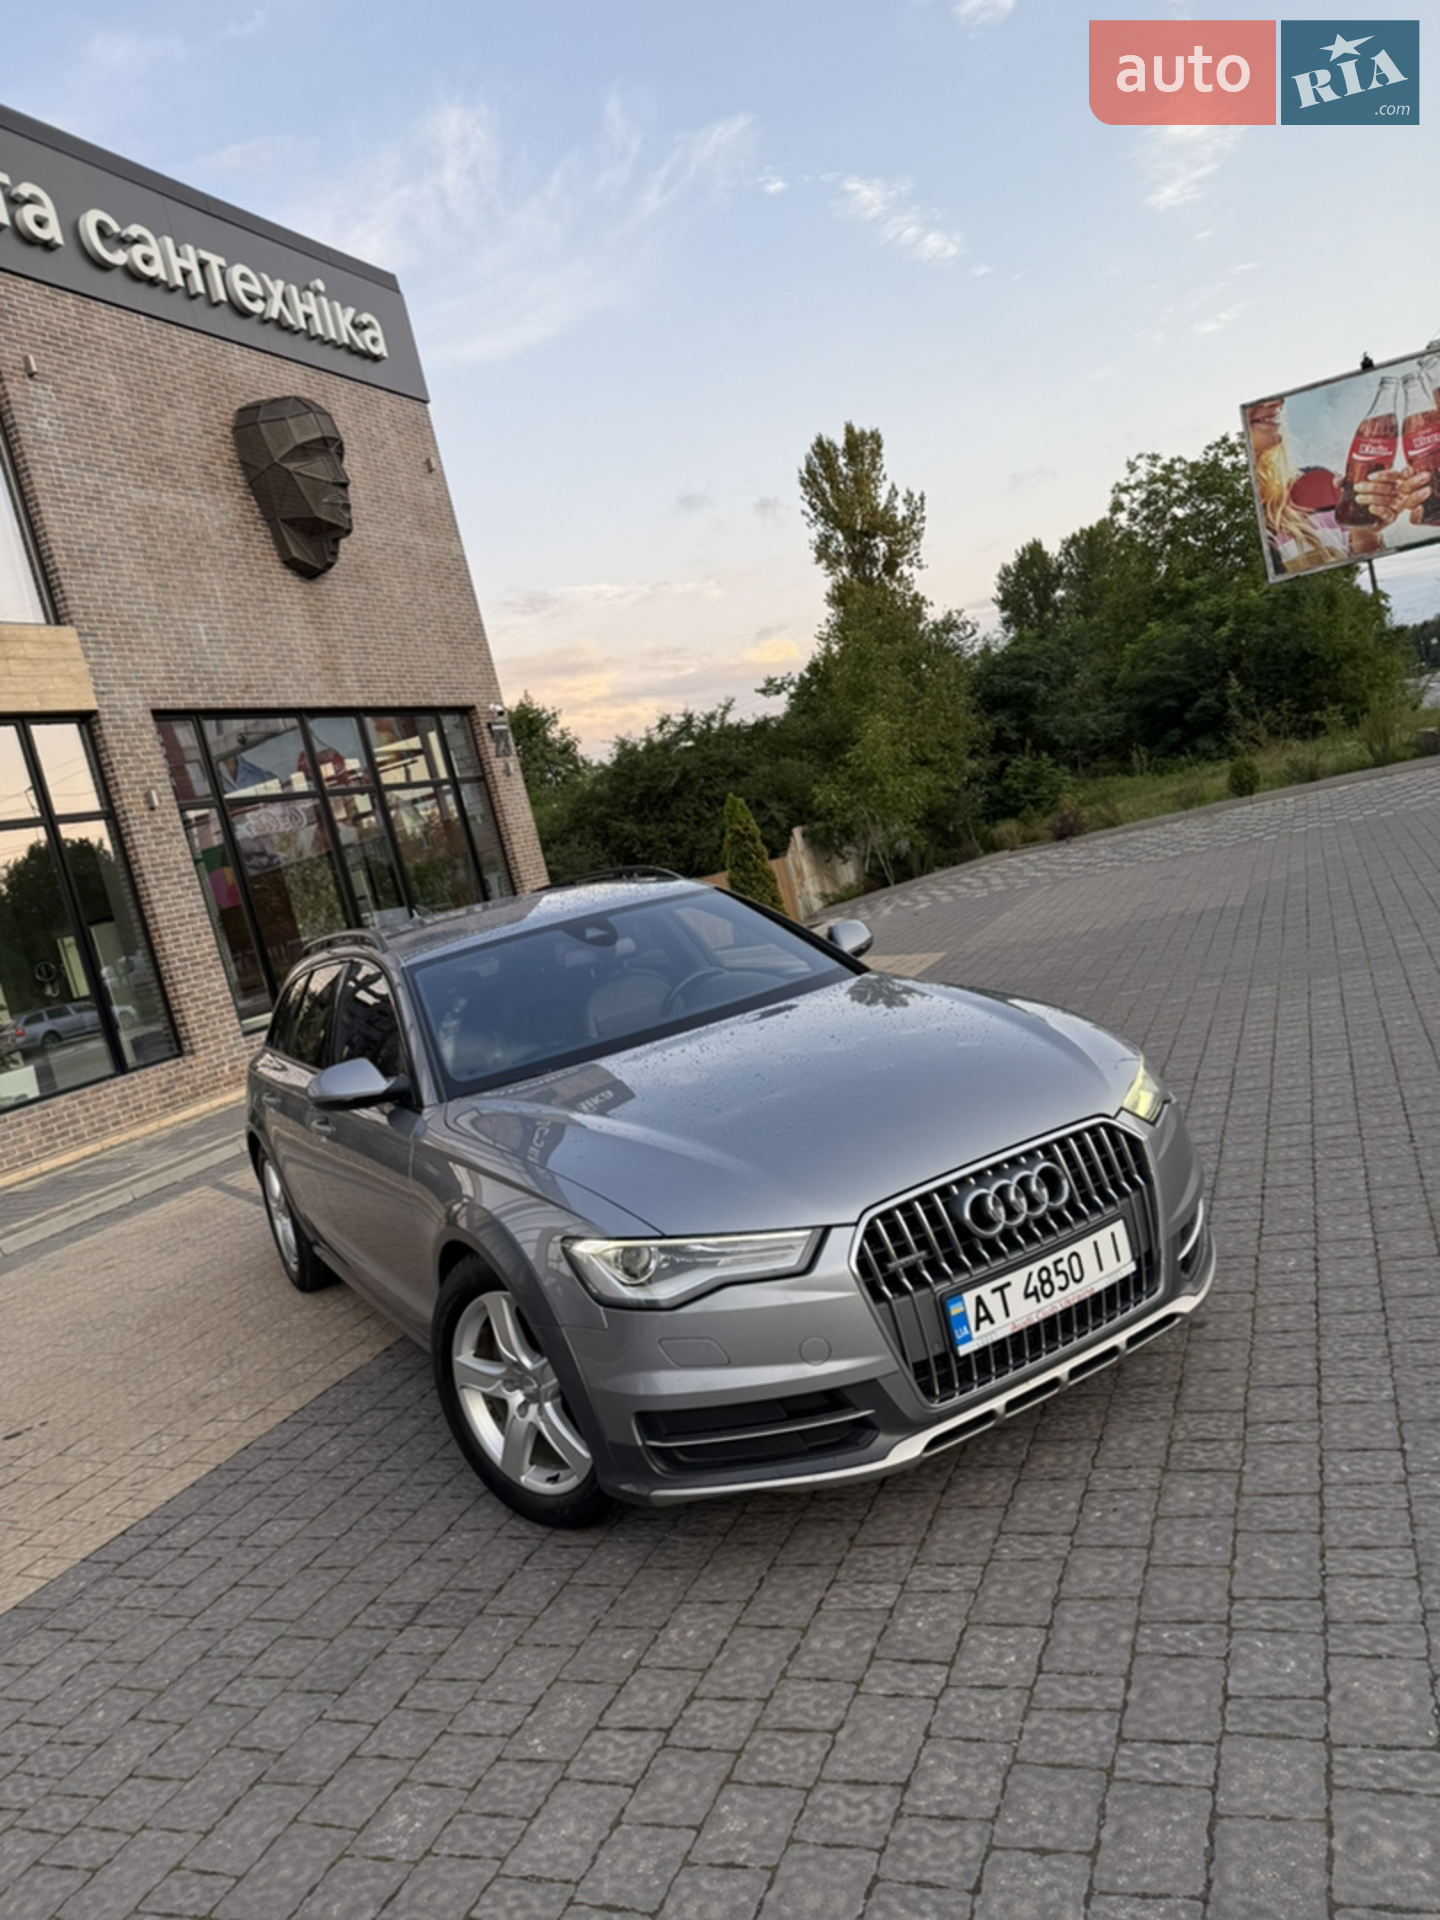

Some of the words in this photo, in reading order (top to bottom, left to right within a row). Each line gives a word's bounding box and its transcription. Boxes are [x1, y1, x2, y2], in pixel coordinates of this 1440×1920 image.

[78, 208, 389, 361] сантехніка
[954, 1325, 969, 1340] UA
[974, 1281, 1013, 1332] AT
[1023, 1250, 1086, 1304] 4850
